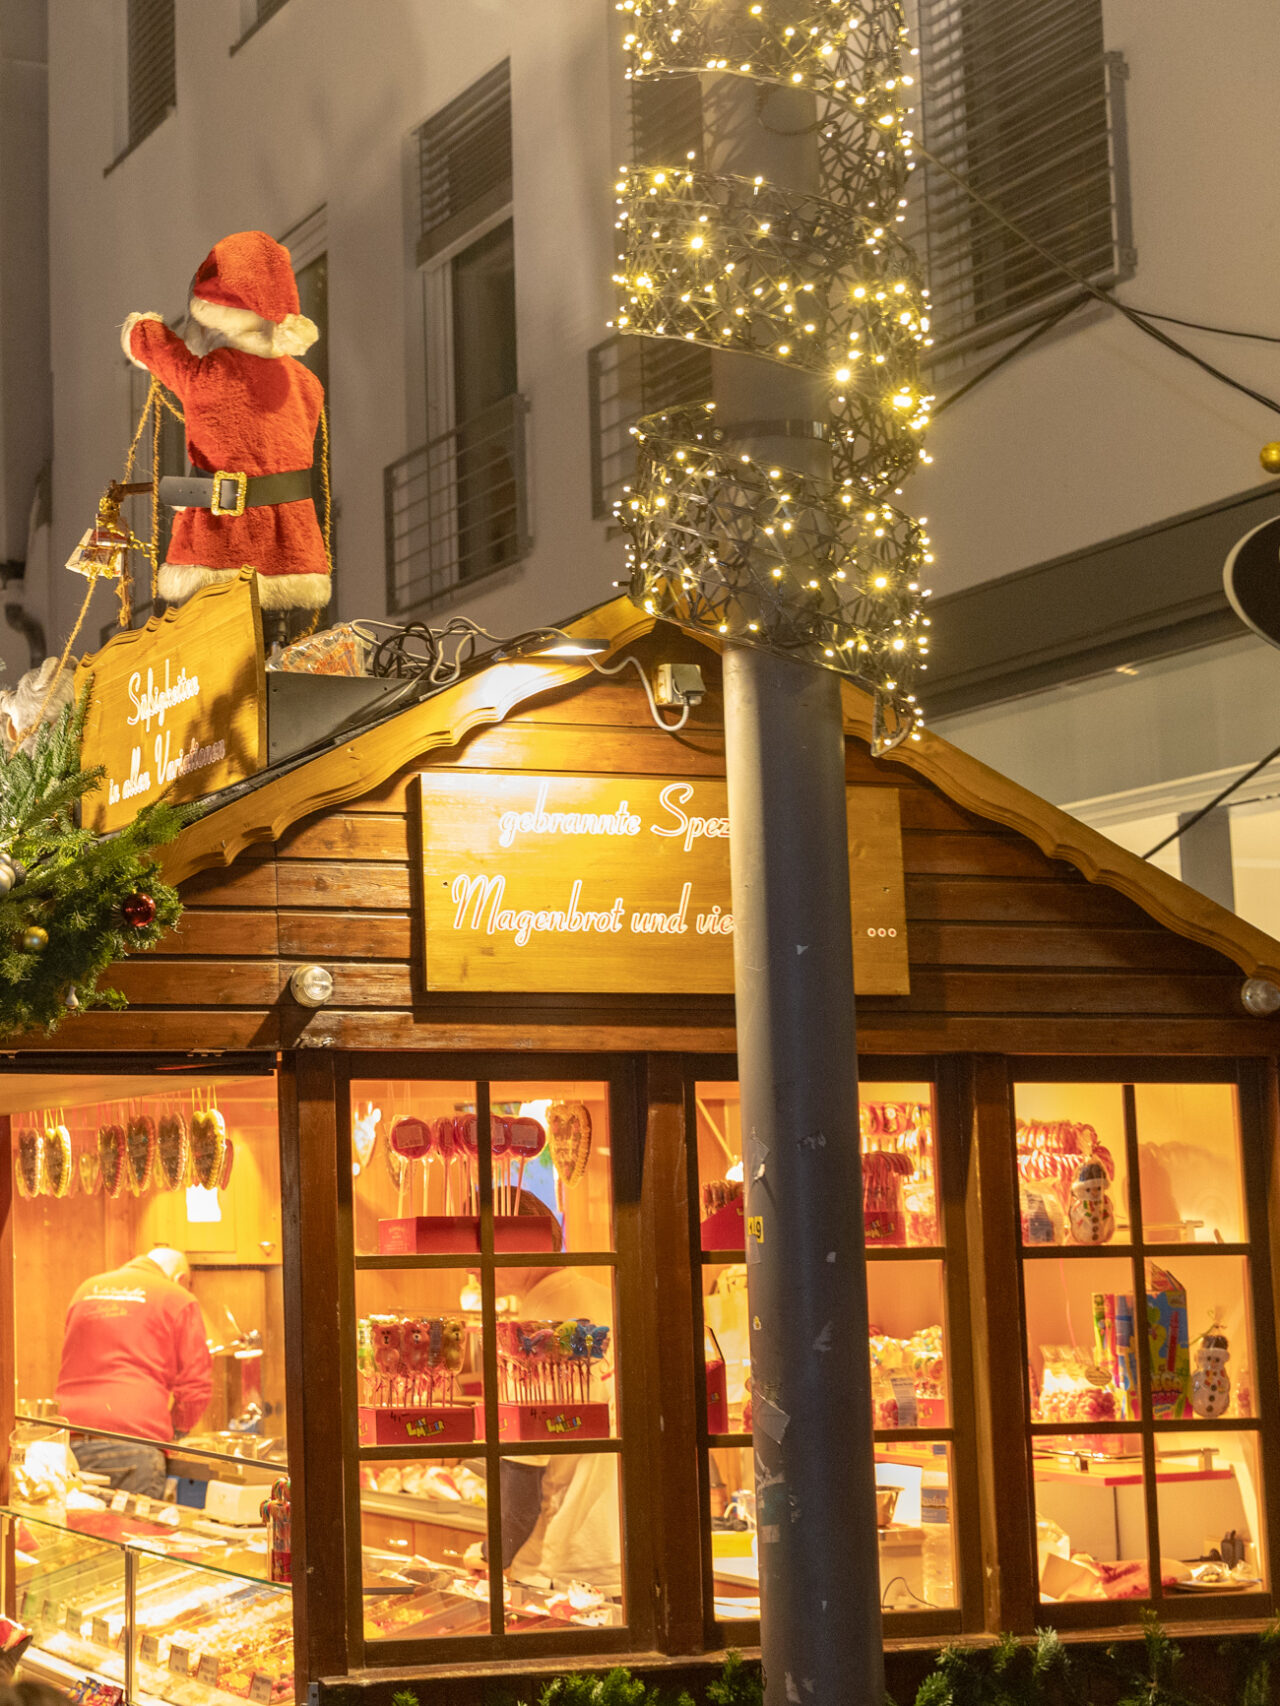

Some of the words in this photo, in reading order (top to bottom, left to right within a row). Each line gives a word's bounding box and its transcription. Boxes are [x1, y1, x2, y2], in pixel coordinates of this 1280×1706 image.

[108, 778, 120, 805] in
[122, 746, 151, 799] allen
[155, 730, 226, 785] Variationen
[498, 782, 641, 848] gebrannte
[651, 782, 731, 852] Spez
[451, 873, 625, 947] Magenbrot
[630, 882, 692, 935] und
[695, 901, 734, 935] vie
